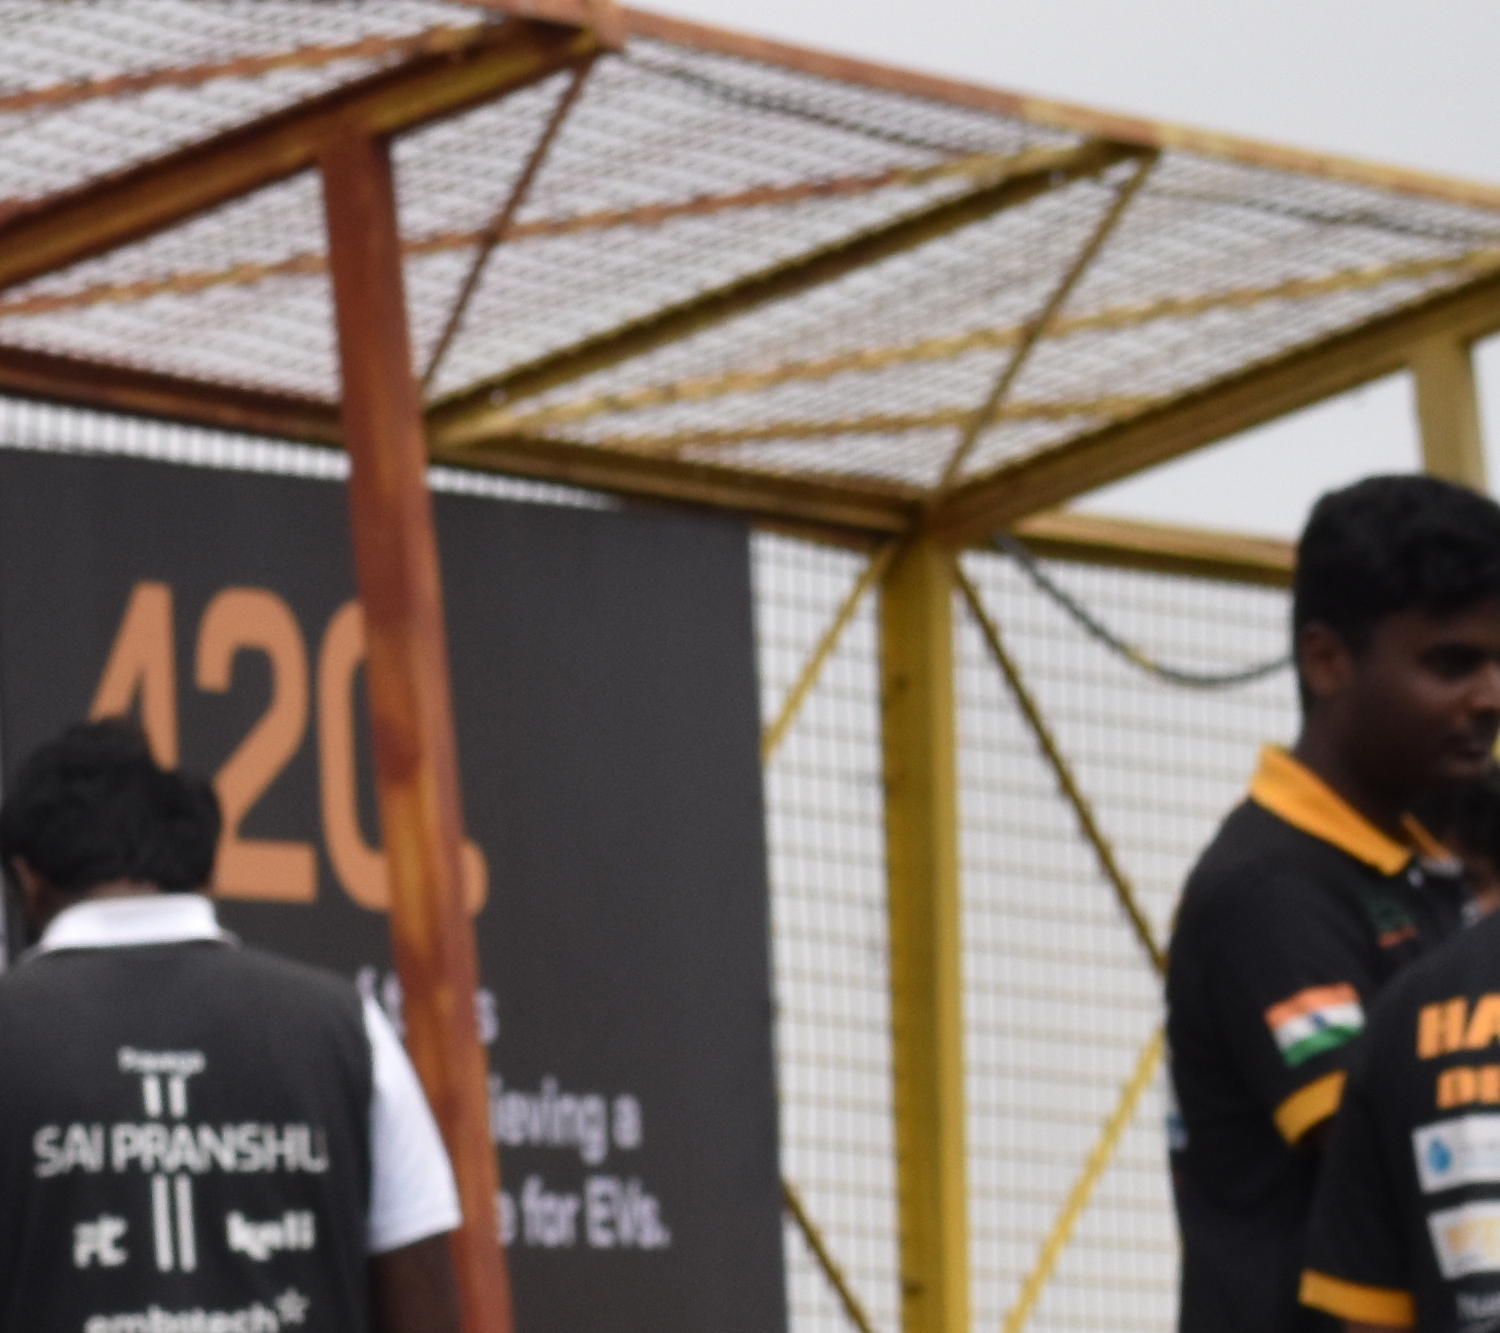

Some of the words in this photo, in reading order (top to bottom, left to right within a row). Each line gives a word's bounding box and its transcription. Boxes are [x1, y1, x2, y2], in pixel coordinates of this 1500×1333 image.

[34, 1120, 106, 1181] SAI
[613, 1093, 642, 1150] a
[522, 1173, 578, 1249] for
